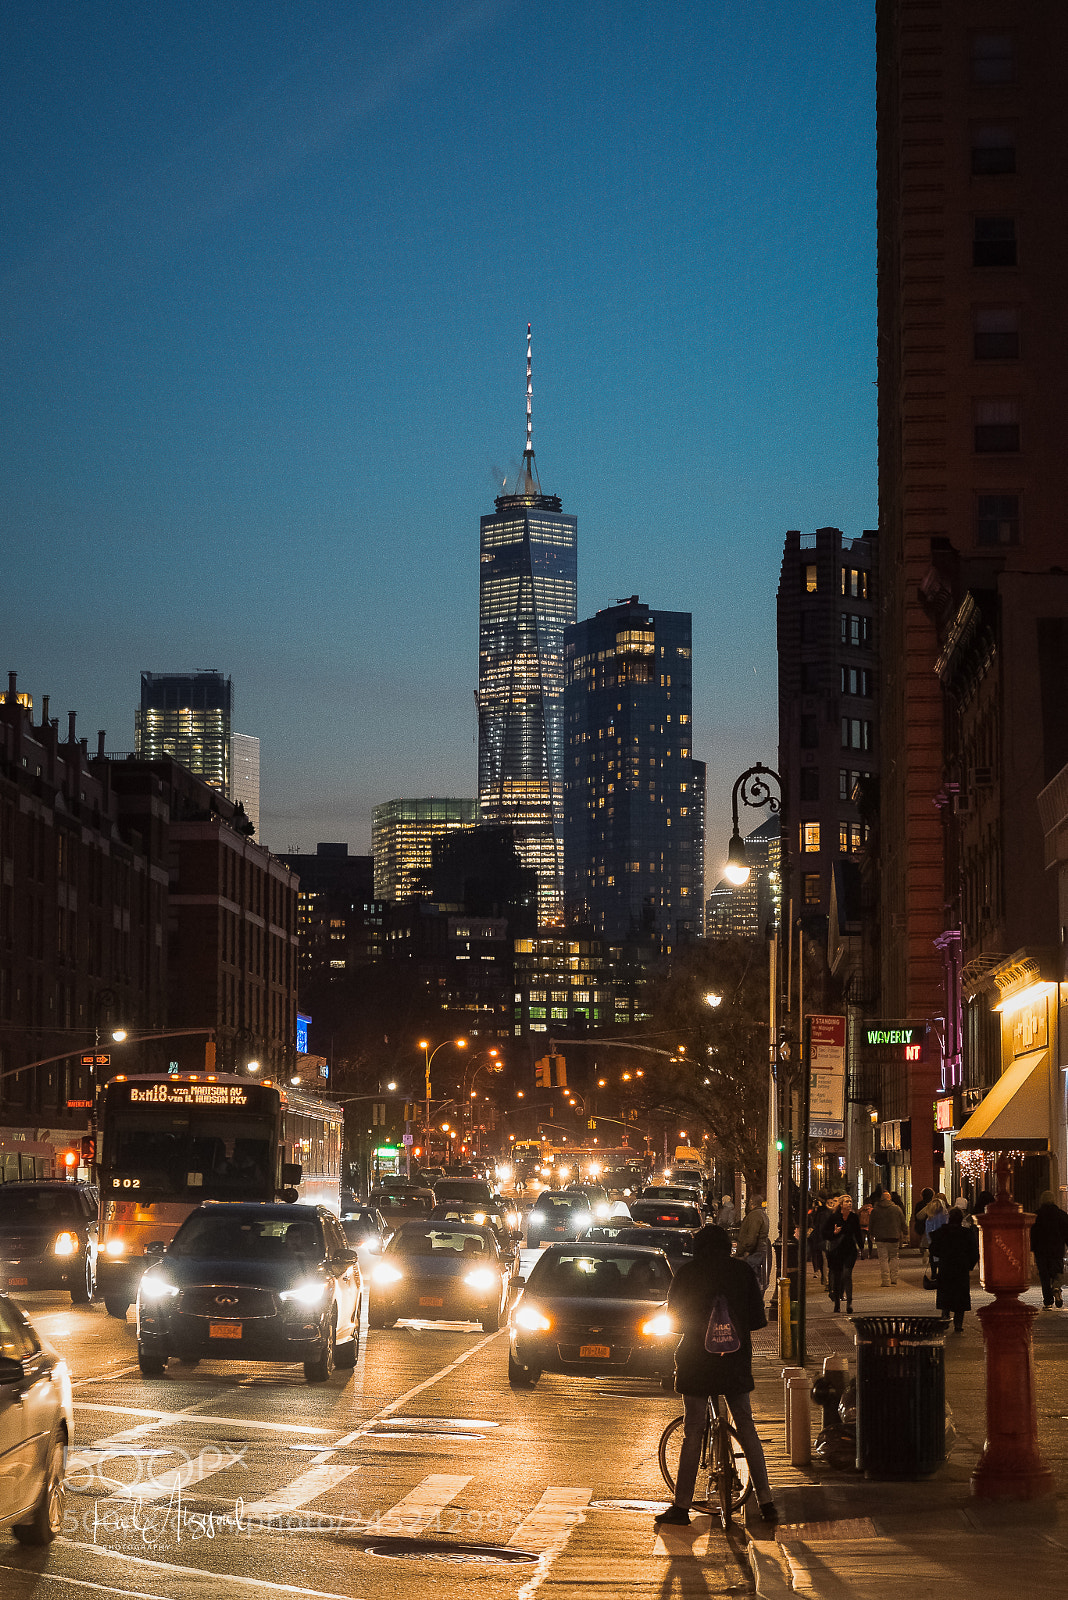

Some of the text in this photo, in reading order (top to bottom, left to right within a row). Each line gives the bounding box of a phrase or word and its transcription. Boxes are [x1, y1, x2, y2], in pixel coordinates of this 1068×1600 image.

[816, 1018, 840, 1026] STANDING
[867, 1029, 913, 1044] WAVERLY
[130, 1084, 168, 1102] BxM18
[190, 1086, 228, 1096] MADISON
[230, 1087, 243, 1096] AV
[195, 1096, 228, 1104] HUDSON
[230, 1096, 247, 1105] PKY
